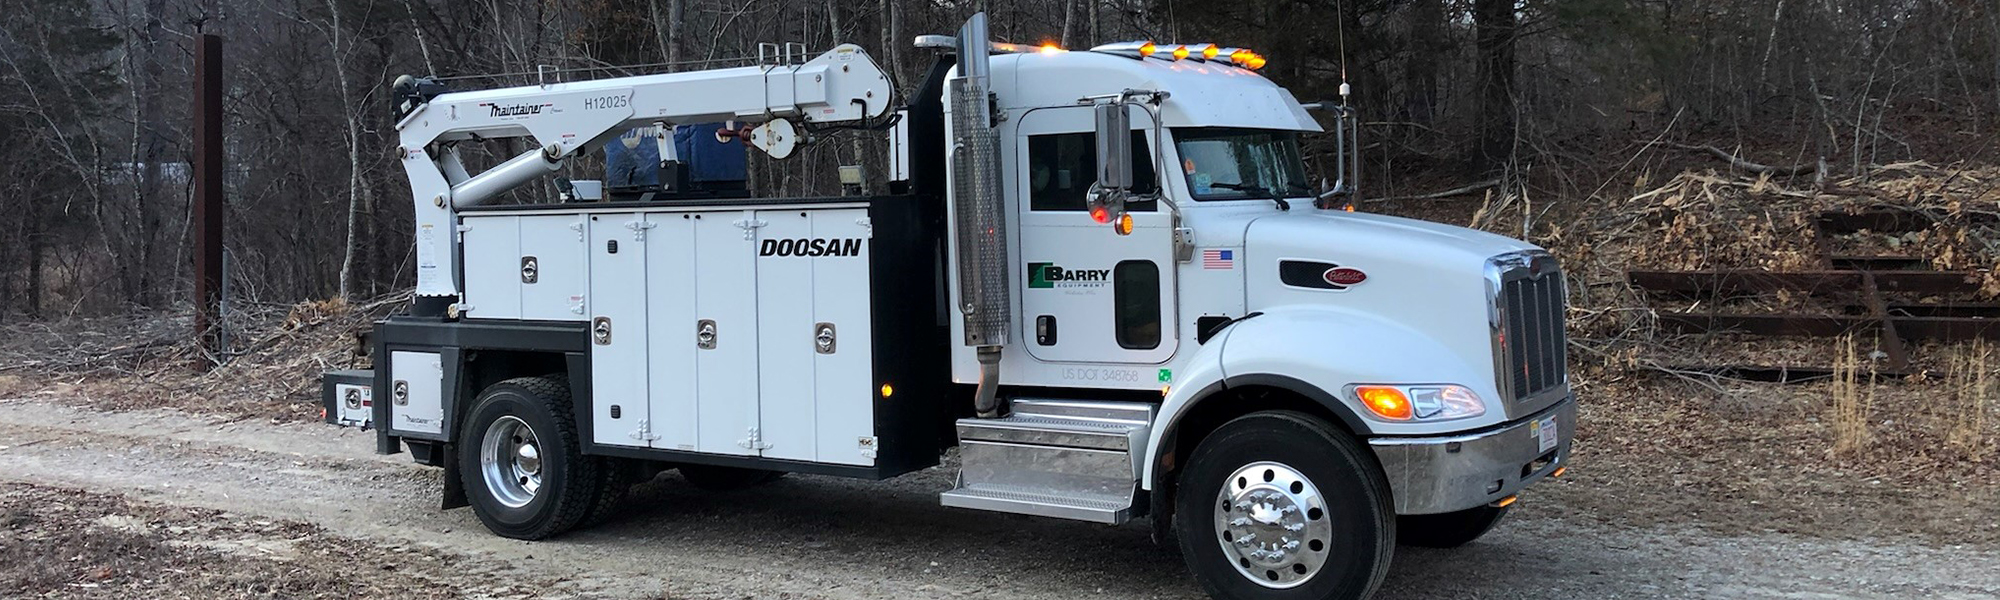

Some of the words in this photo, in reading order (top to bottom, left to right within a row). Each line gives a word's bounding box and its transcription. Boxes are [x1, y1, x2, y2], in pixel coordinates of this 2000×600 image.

[487, 103, 544, 117] Maintainer
[585, 95, 627, 110] H12025
[759, 239, 862, 257] DOOSAN
[1045, 266, 1110, 281] BARRY
[1062, 368, 1074, 380] US
[1077, 369, 1099, 381] DOT
[1103, 369, 1139, 382] 348768
